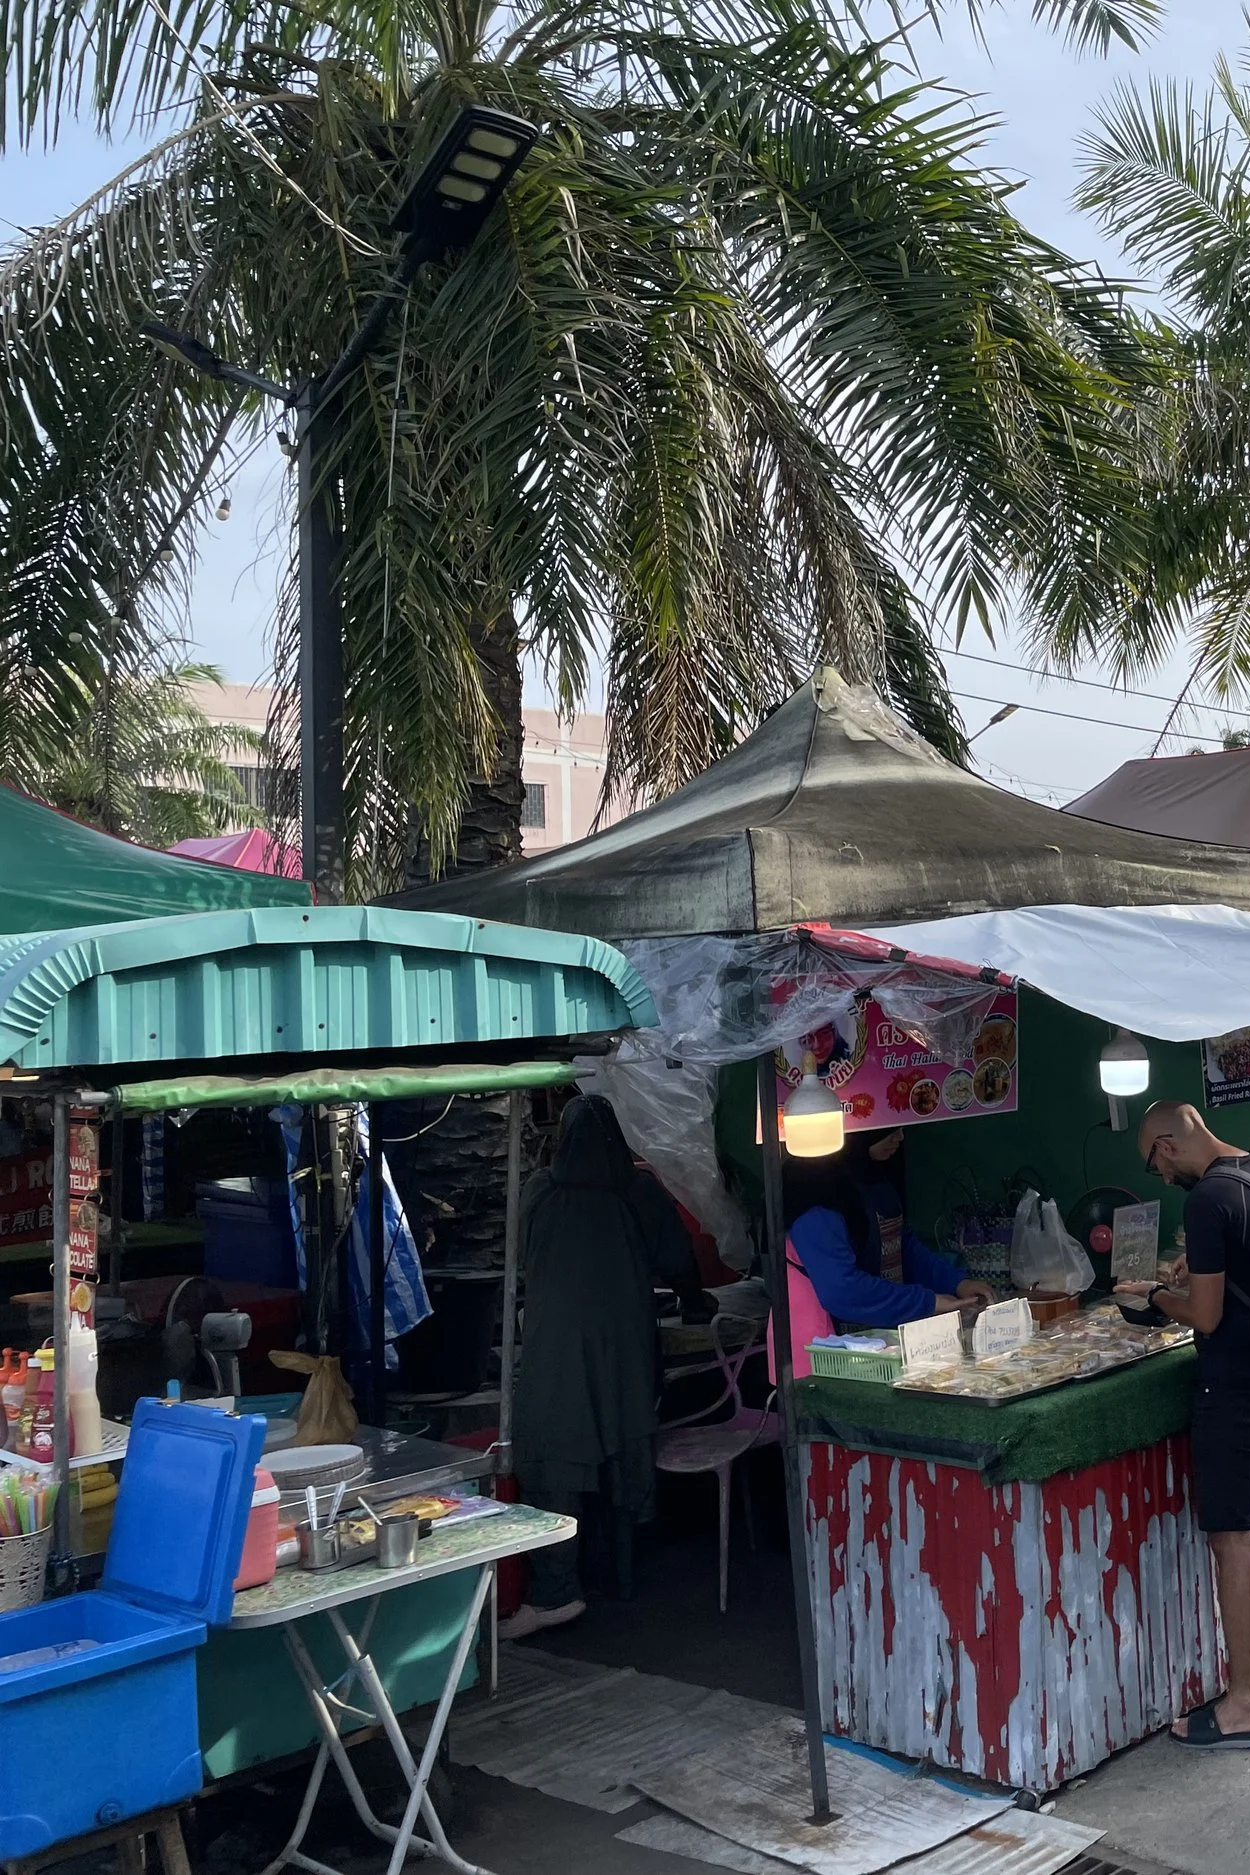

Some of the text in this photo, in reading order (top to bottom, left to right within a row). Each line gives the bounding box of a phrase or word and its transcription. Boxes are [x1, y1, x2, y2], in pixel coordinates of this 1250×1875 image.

[1211, 1093, 1227, 1104] Basil
[1228, 1090, 1244, 1101] Fried
[1127, 1252, 1141, 1267] 25
